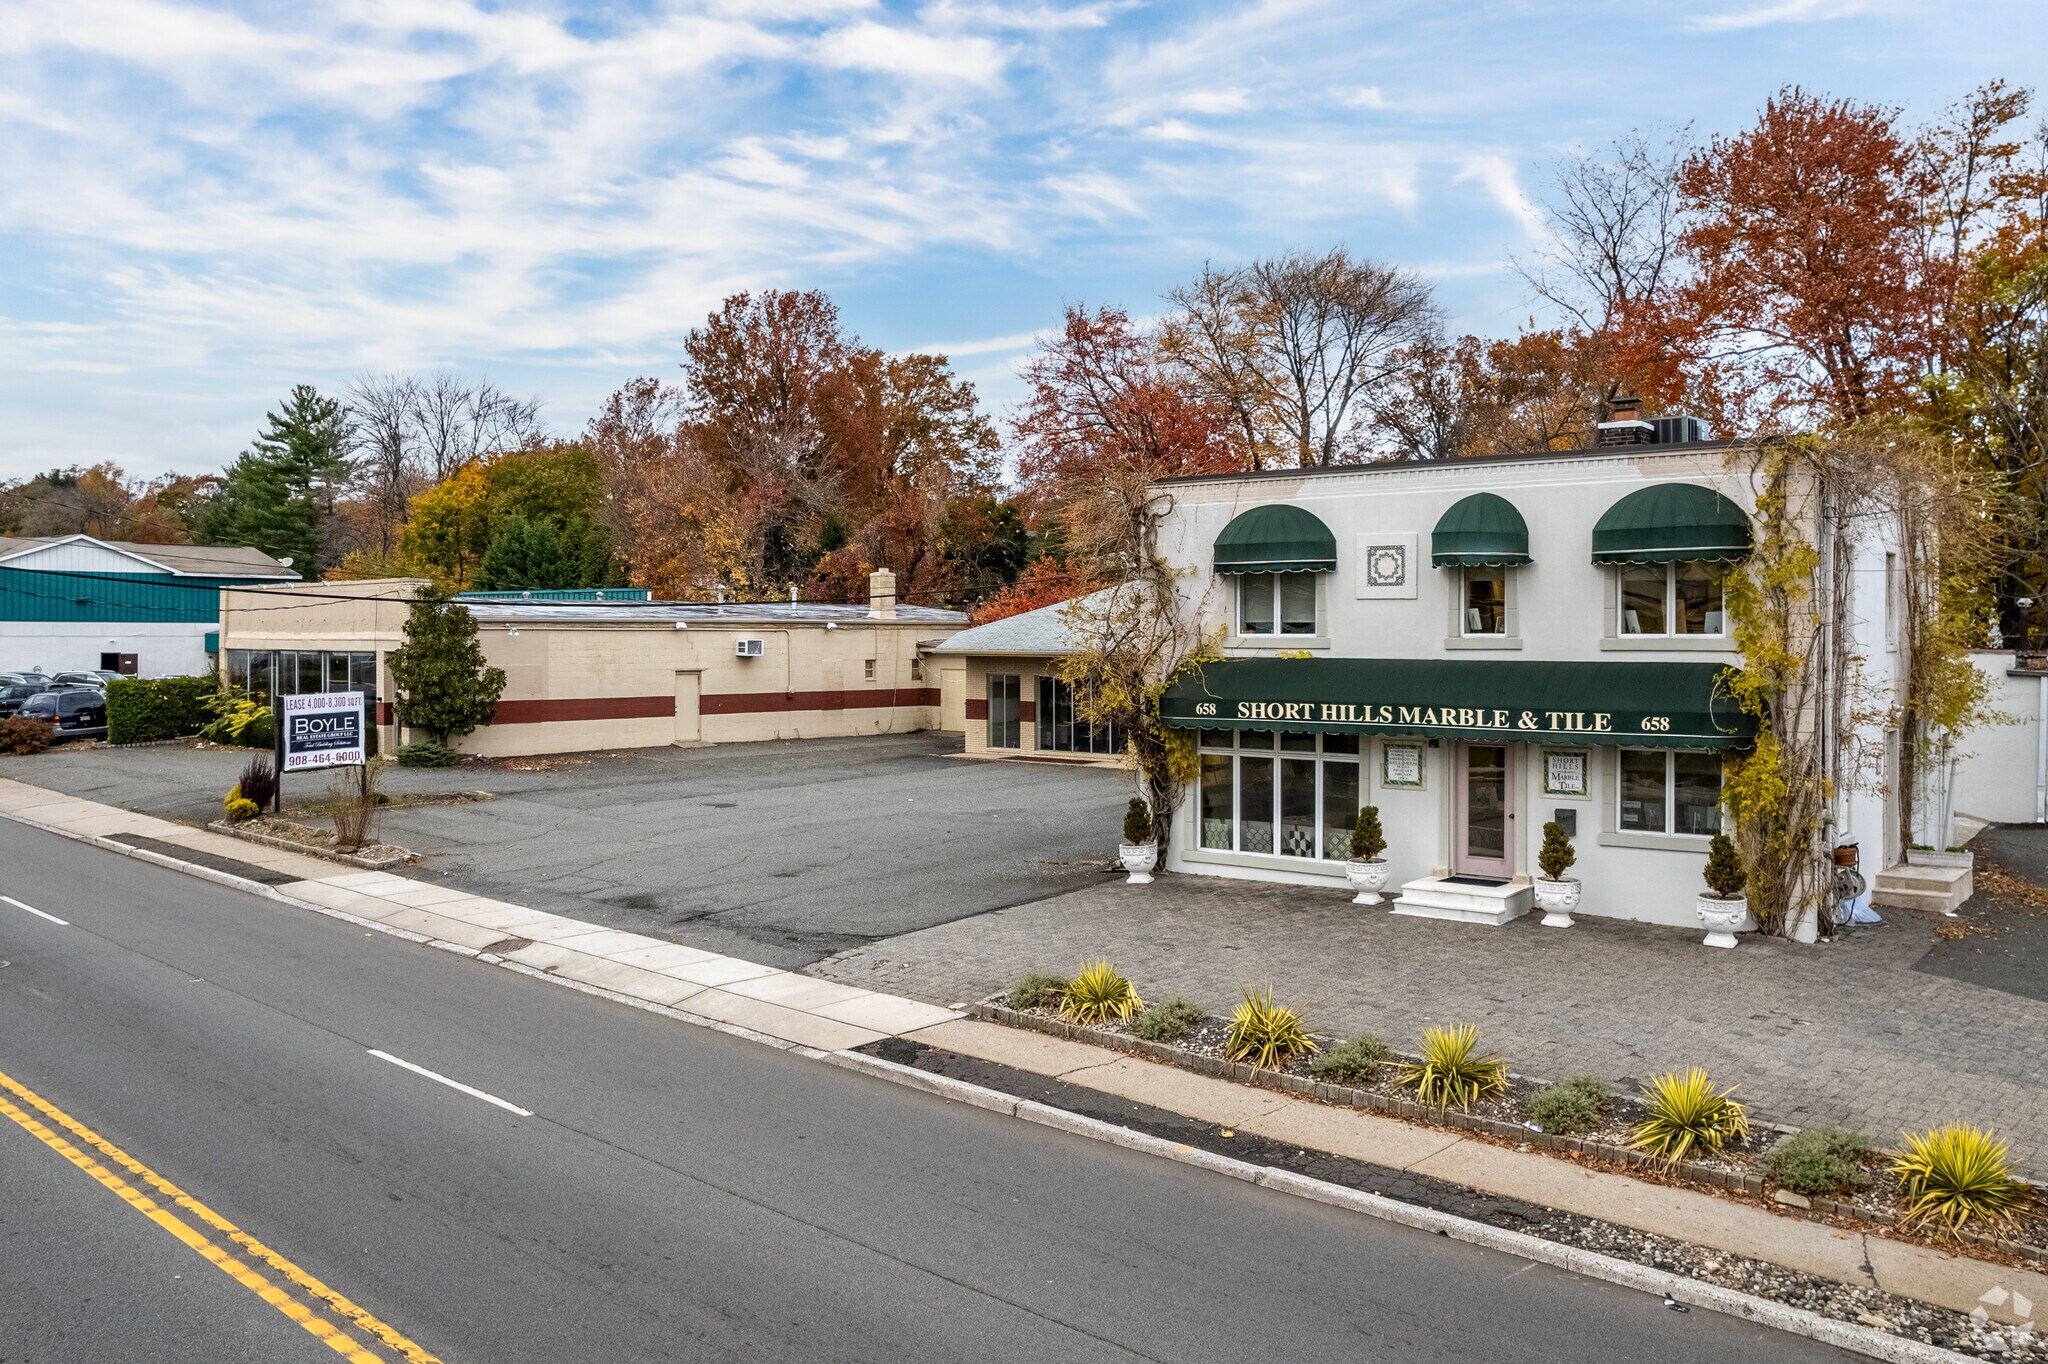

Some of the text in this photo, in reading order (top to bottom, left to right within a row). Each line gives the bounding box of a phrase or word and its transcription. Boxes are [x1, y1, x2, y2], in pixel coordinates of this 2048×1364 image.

[286, 699, 305, 710] LEASE
[308, 697, 346, 710] 4,000-8,300
[1195, 703, 1216, 715] 658
[1237, 701, 1612, 732] SHORT HILLS MARBLE & TILE
[1641, 716, 1670, 731] 658
[295, 717, 354, 734] BOYLE
[289, 751, 360, 766] 908-464-6000
[1551, 772, 1580, 781] MARBLE
[1558, 781, 1576, 789] TILE
